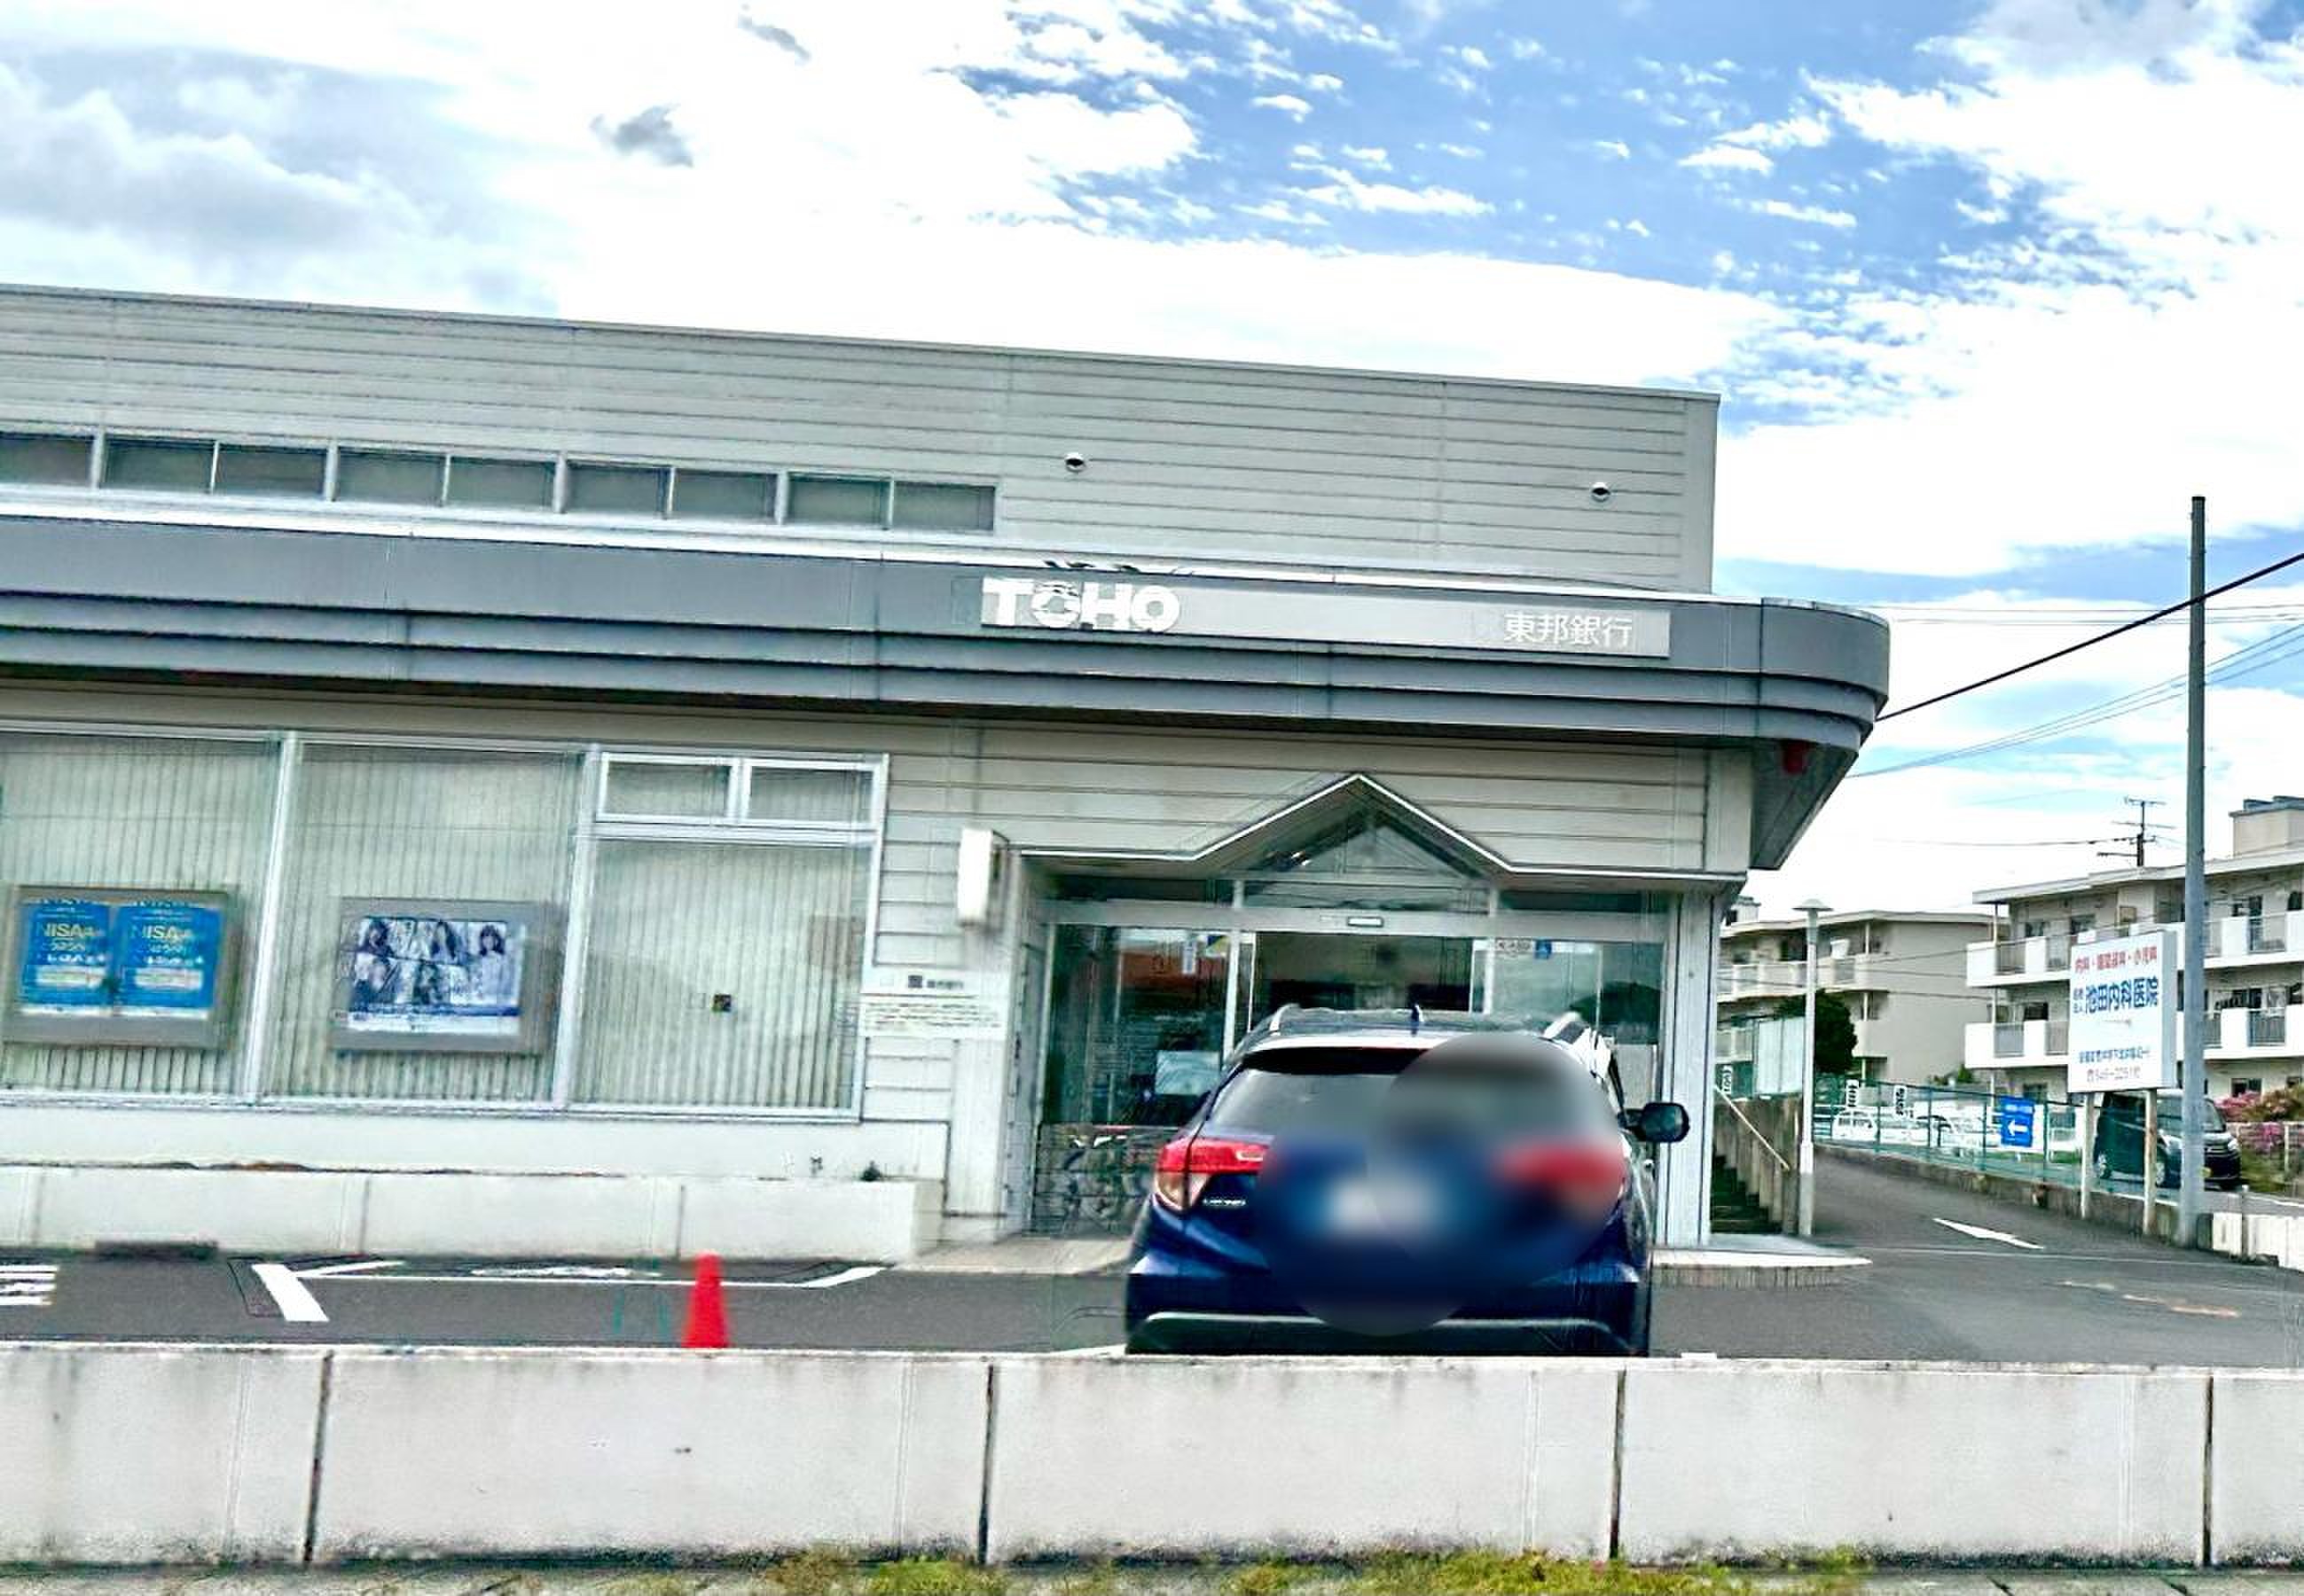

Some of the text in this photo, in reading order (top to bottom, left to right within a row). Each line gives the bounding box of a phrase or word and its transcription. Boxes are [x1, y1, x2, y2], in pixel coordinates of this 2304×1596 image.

[982, 576, 1180, 633] TOHO
[1503, 610, 1634, 648] 東邦銀行
[2084, 975, 2159, 1013] 池田内科医院
